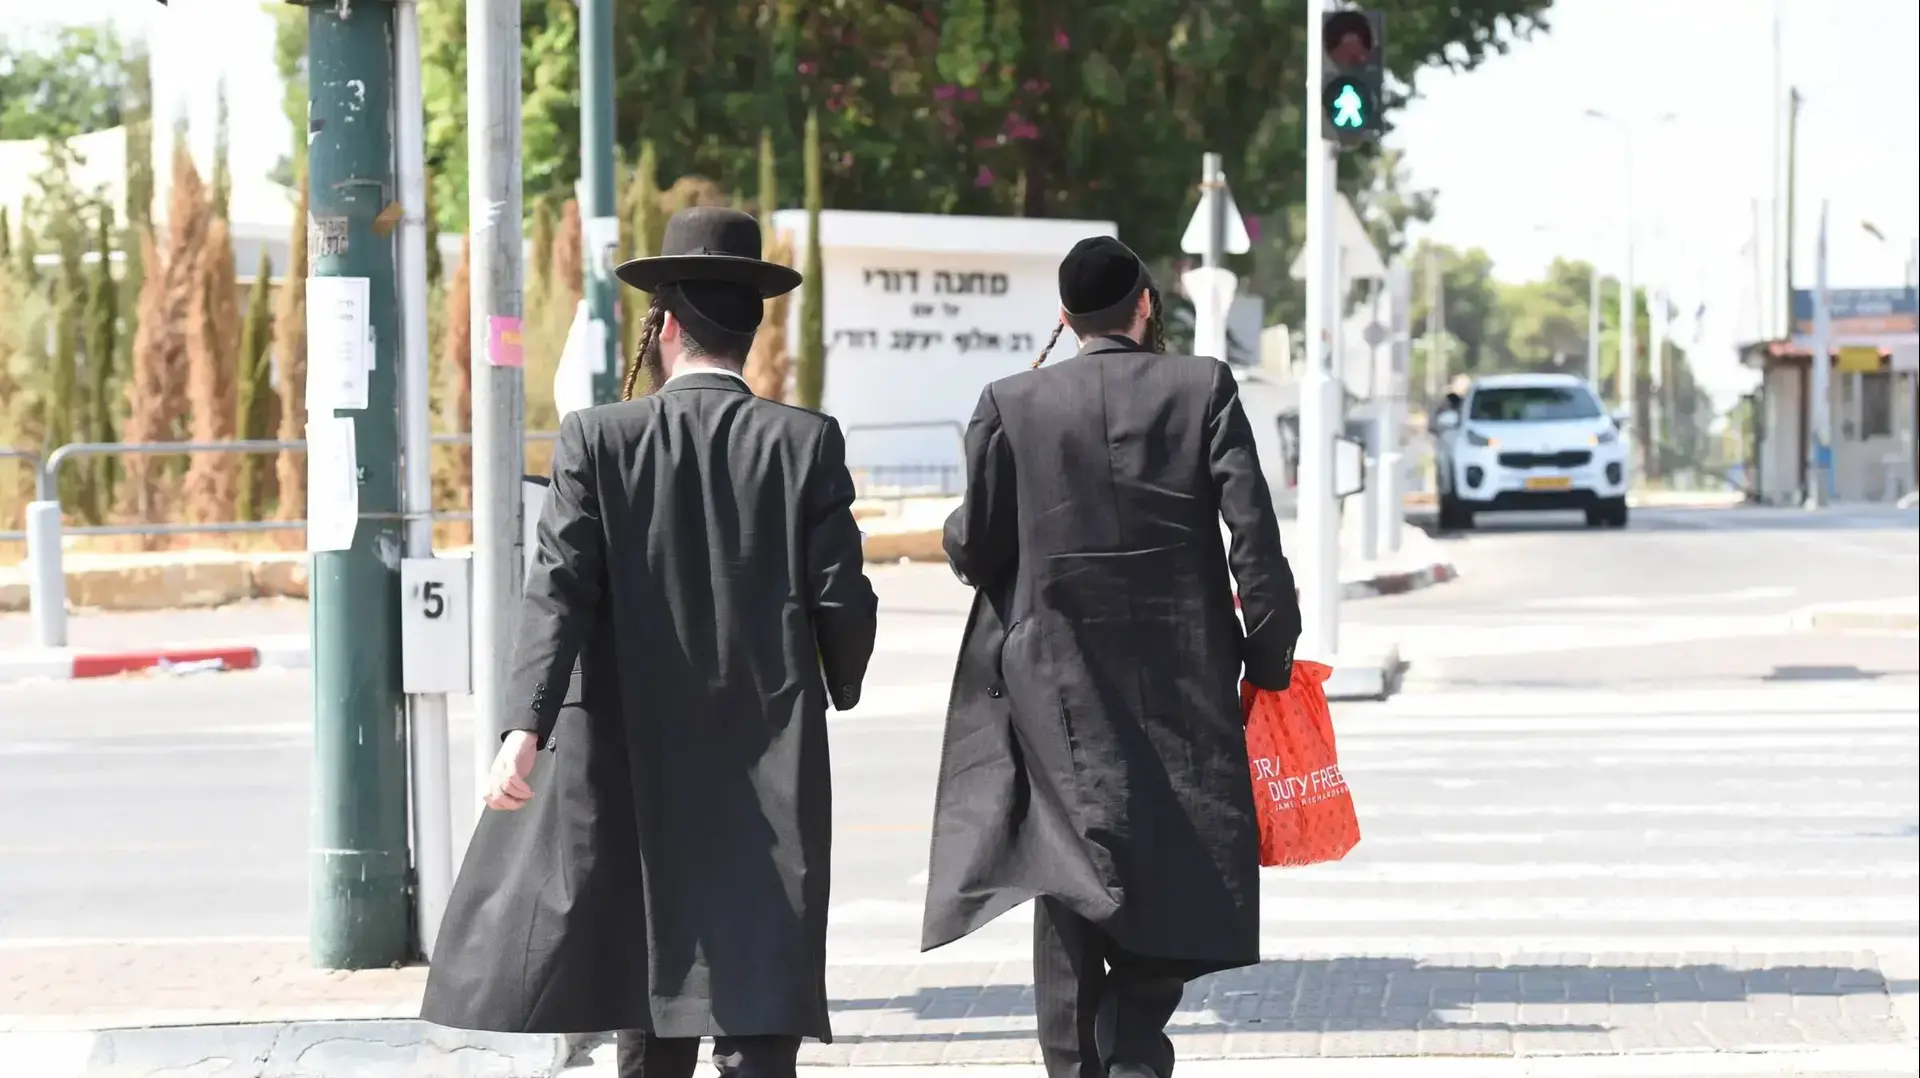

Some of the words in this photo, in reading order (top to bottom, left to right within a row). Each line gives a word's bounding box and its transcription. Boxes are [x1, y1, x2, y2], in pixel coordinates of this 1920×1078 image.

[863, 268, 919, 293] דורי
[933, 269, 1009, 295] מחנה
[890, 328, 942, 350] יעקב
[423, 581, 444, 619] 5
[1268, 774, 1308, 802] DUTY
[1311, 764, 1346, 793] FREE
